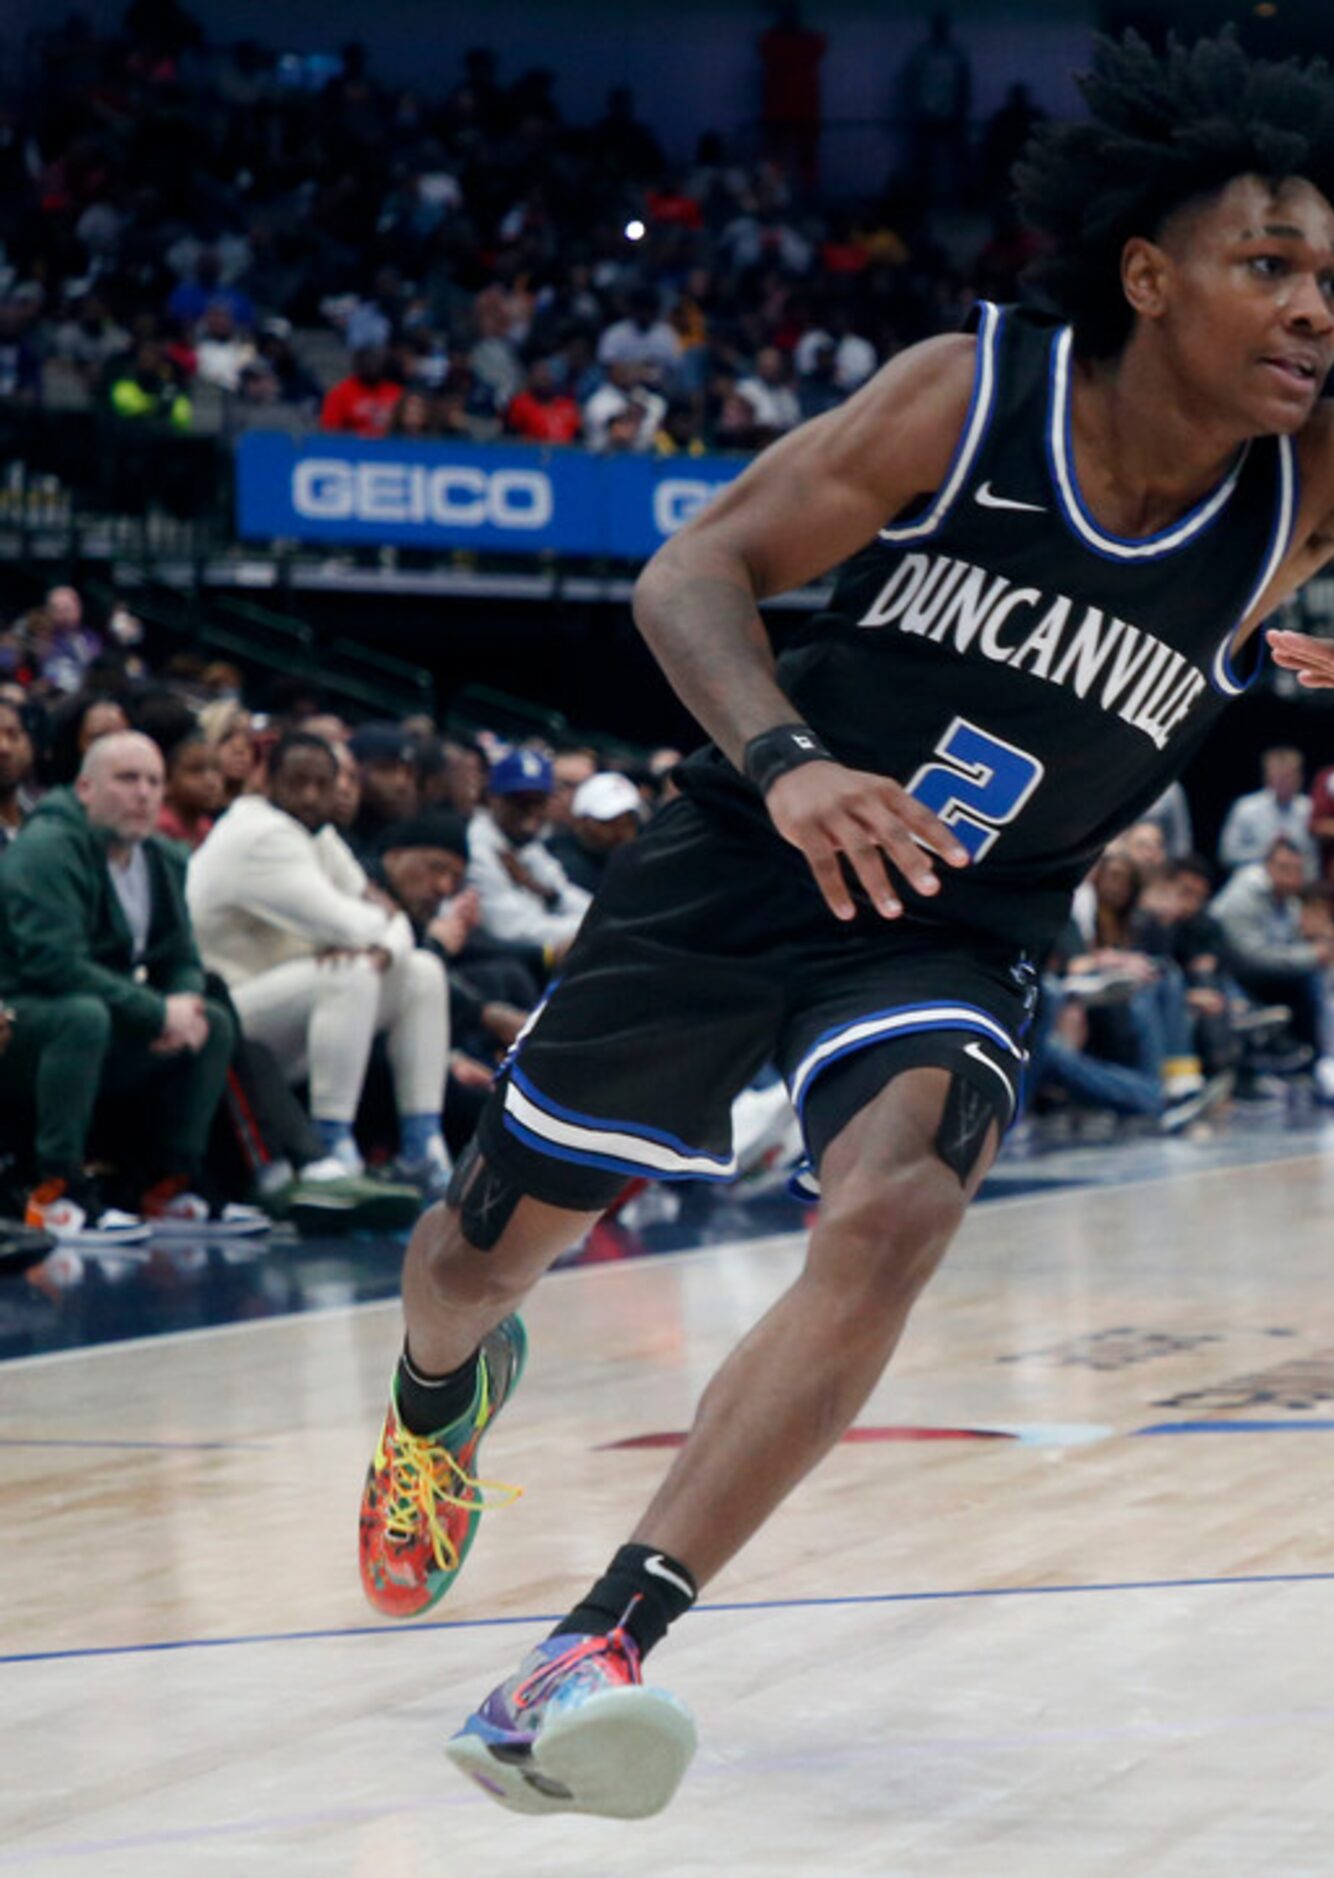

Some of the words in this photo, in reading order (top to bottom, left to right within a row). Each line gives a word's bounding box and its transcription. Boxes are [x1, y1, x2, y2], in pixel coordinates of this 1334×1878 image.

[292, 458, 553, 530] GEICO
[857, 553, 1206, 750] DUNCANVILLE
[905, 715, 1045, 864] 2
